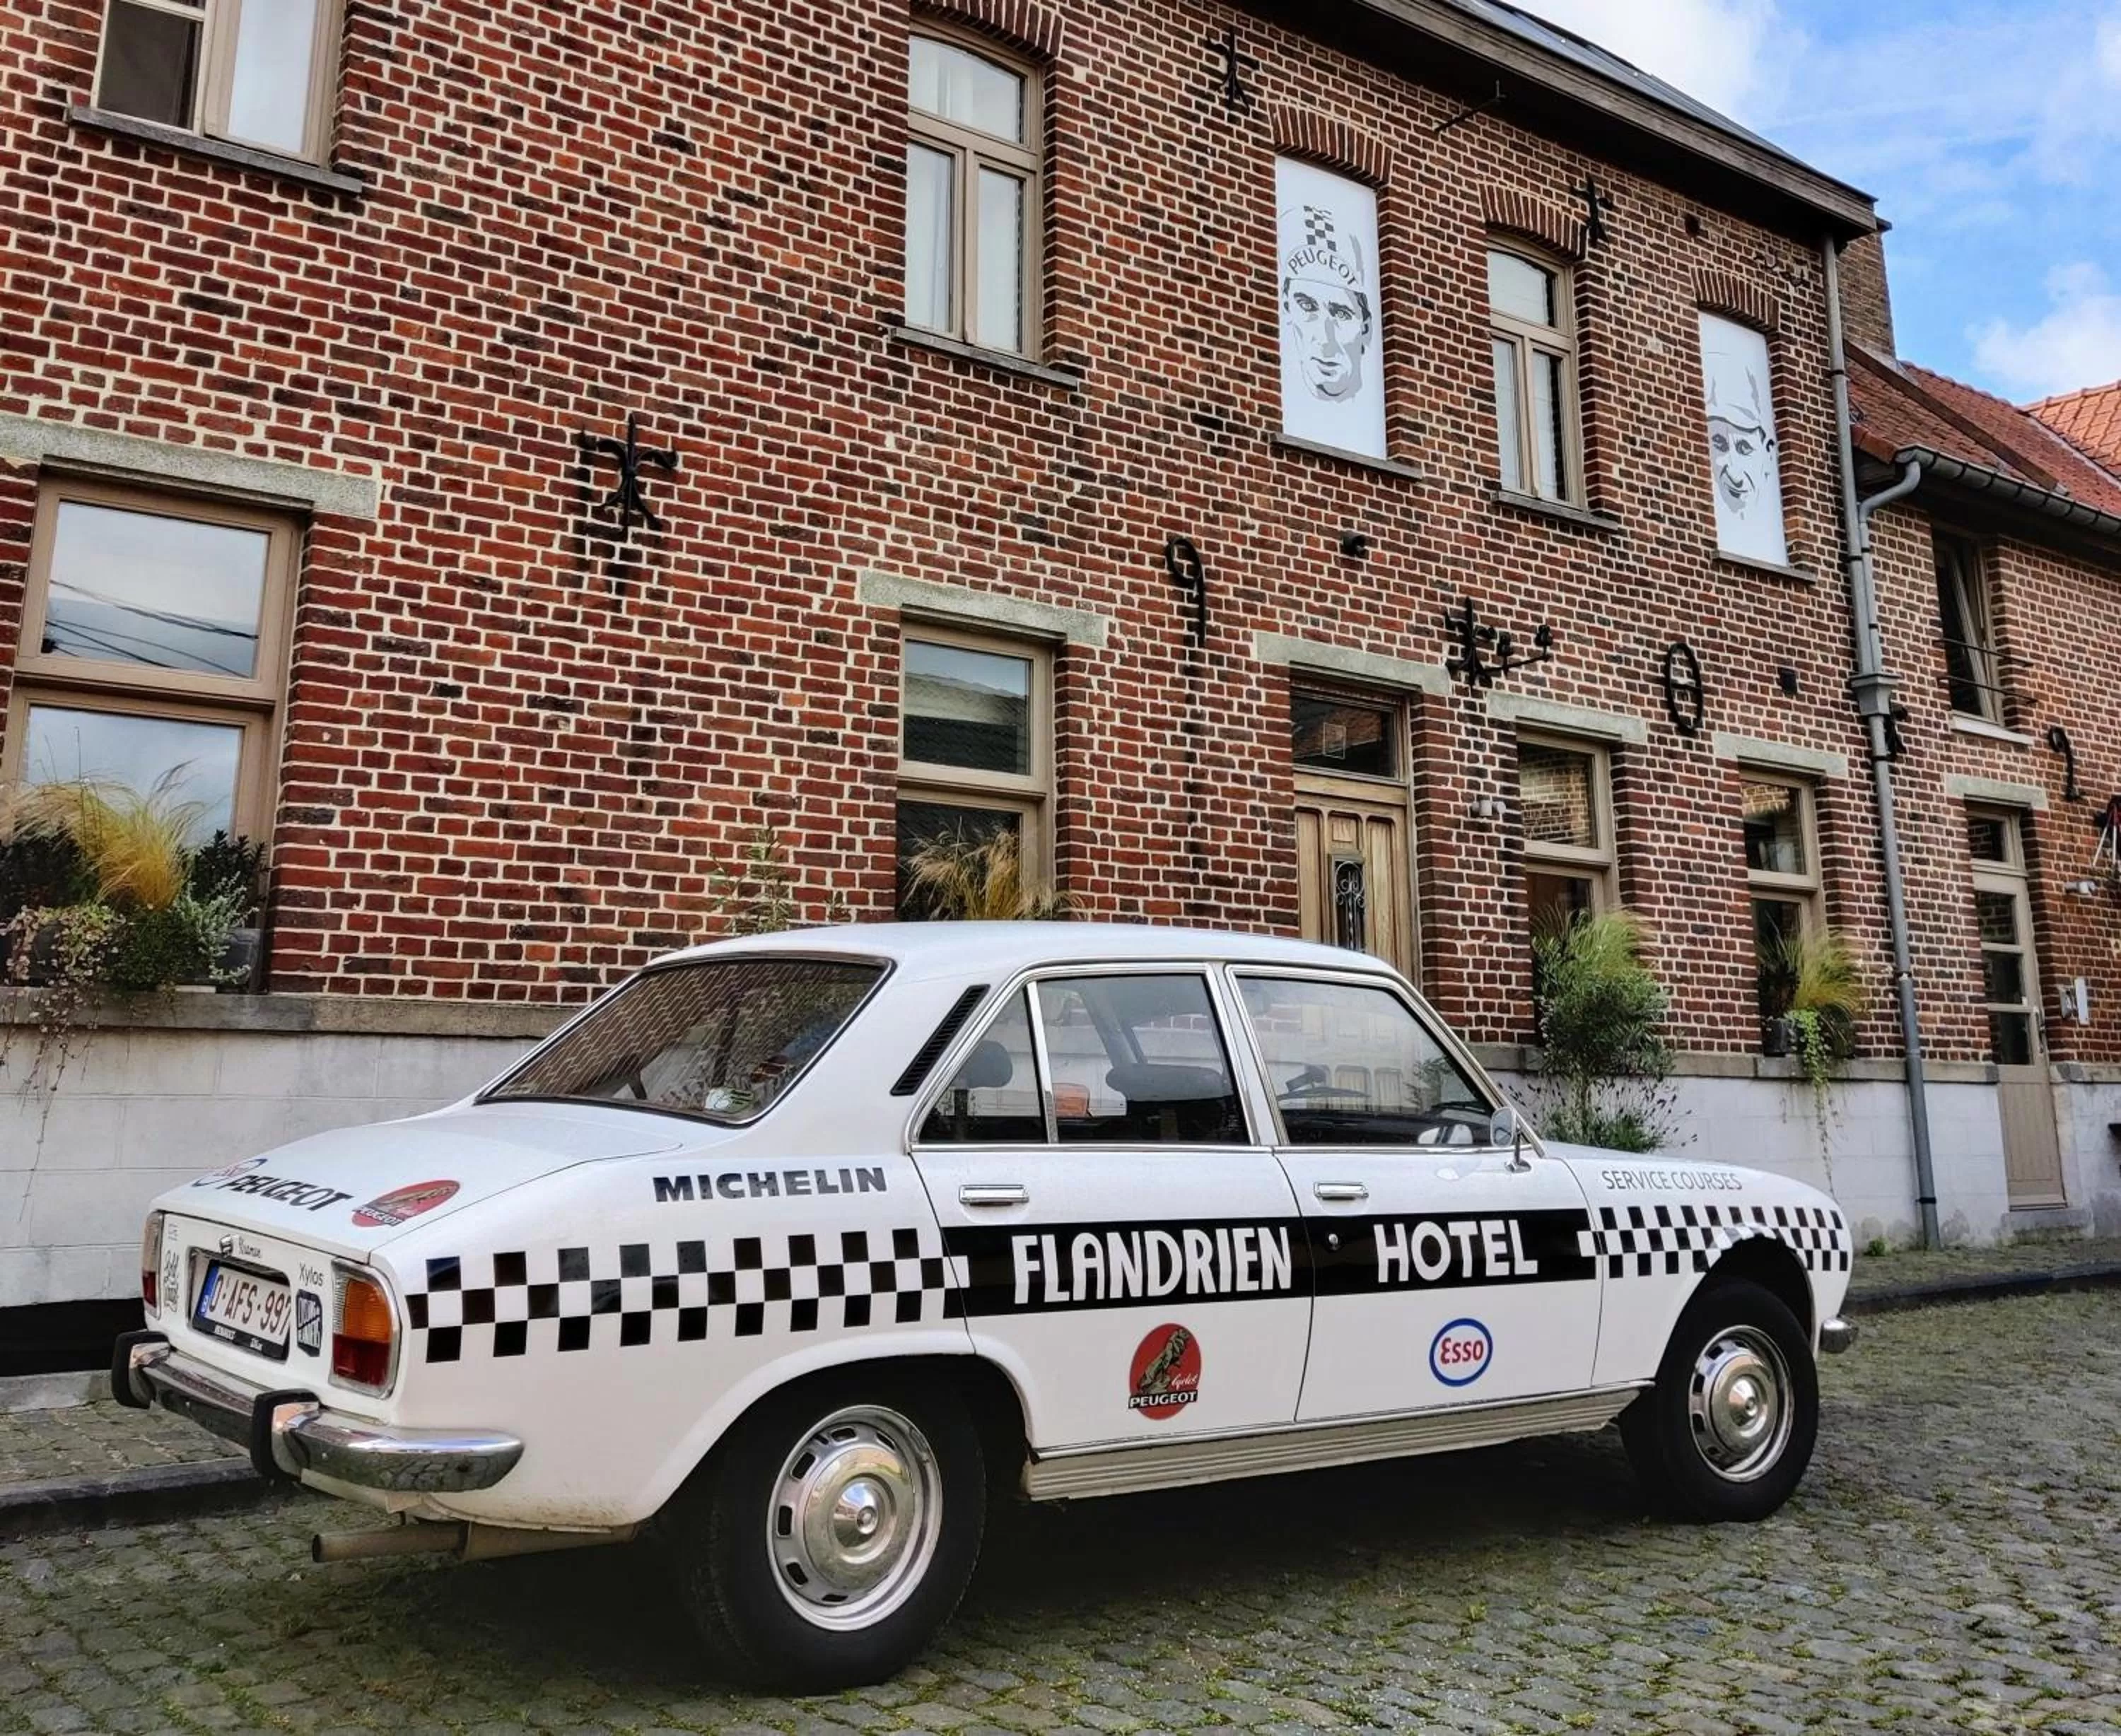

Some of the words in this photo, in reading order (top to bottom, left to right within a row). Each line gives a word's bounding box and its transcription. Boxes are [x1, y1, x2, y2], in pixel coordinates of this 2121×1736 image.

[1287, 248, 1358, 287] PEUGEOT
[216, 1174, 356, 1212] PEUGEOT
[653, 1167, 887, 1202] MICHELIN
[1601, 1170, 1673, 1190] SERVICE
[1671, 1171, 1743, 1191] COURSES
[298, 1261, 324, 1286] Xylos
[1011, 1226, 1292, 1305] FLANDRIEN
[1374, 1219, 1538, 1284] HOTEL
[1130, 1392, 1197, 1407] PEUGEOT
